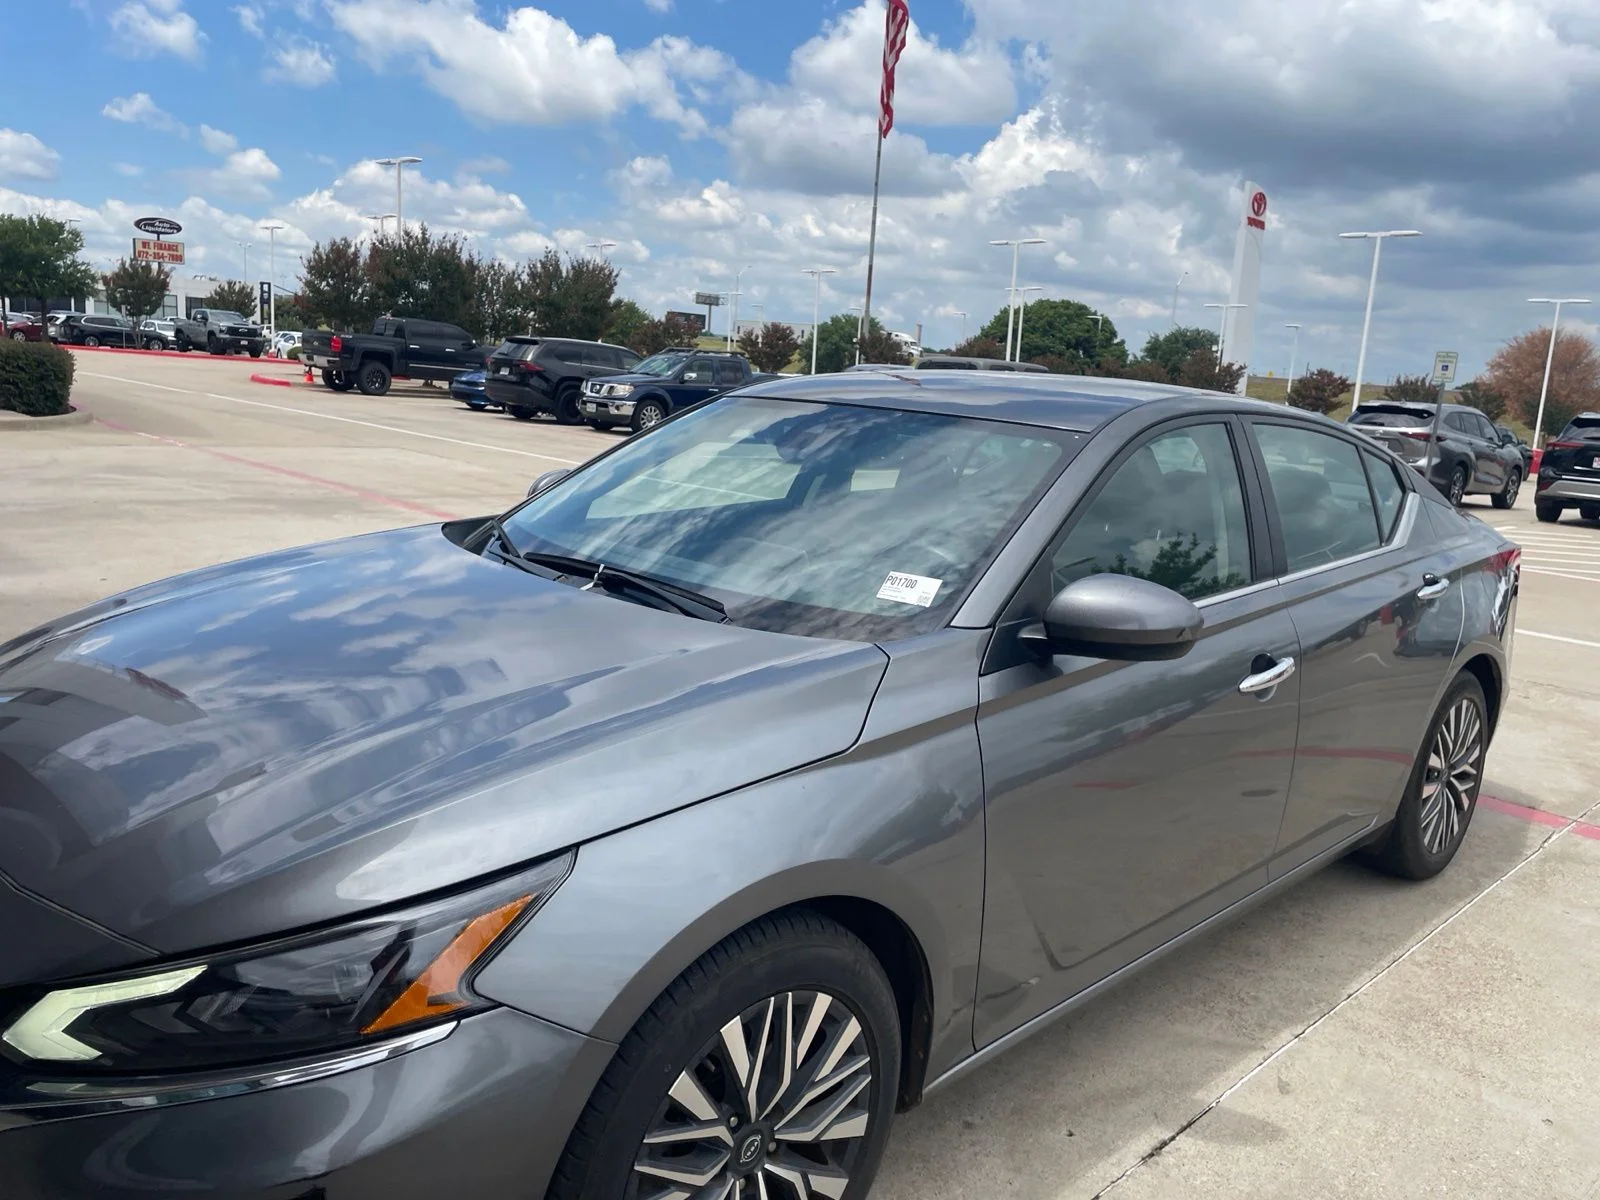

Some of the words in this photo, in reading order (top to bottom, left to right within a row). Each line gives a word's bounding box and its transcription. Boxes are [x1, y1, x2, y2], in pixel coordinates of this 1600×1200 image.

[141, 225, 177, 233] Liquidators
[141, 241, 151, 250] WE
[153, 242, 179, 252] FINANCE
[885, 575, 917, 589] P01700
